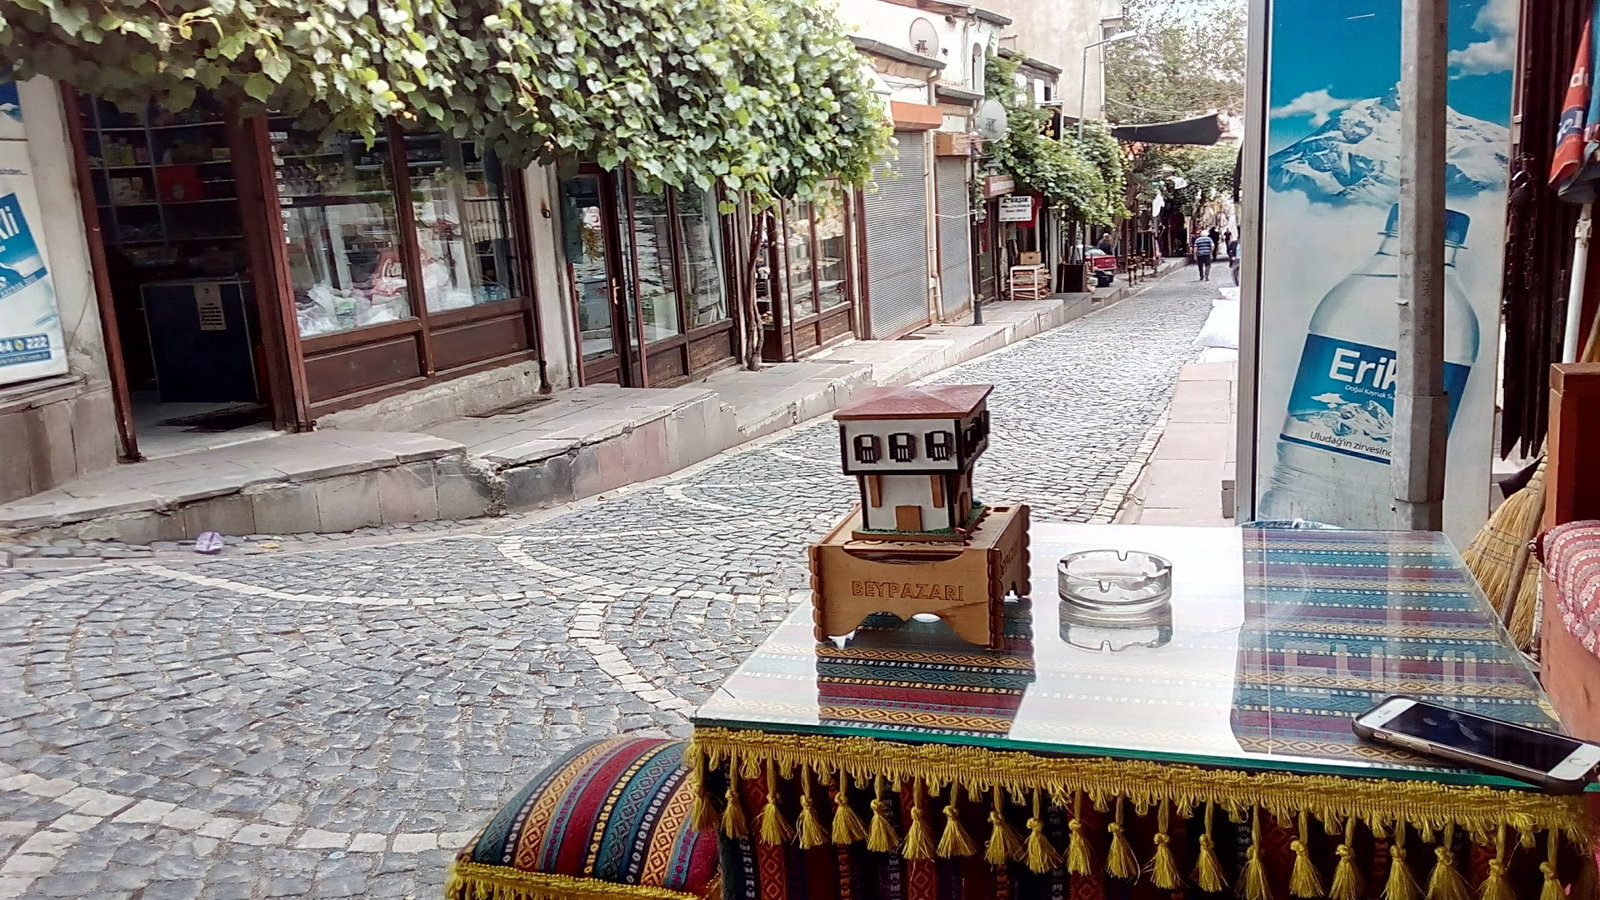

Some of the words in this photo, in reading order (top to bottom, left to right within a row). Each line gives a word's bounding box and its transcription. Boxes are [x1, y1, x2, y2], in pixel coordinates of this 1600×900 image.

[24, 336, 49, 350] 222
[1329, 347, 1396, 390] Erik
[1344, 384, 1364, 395] Doğal
[1364, 388, 1386, 399] Kaynak
[1310, 431, 1352, 447] Uludağ'ın
[852, 580, 965, 602] BEYPAZARI
